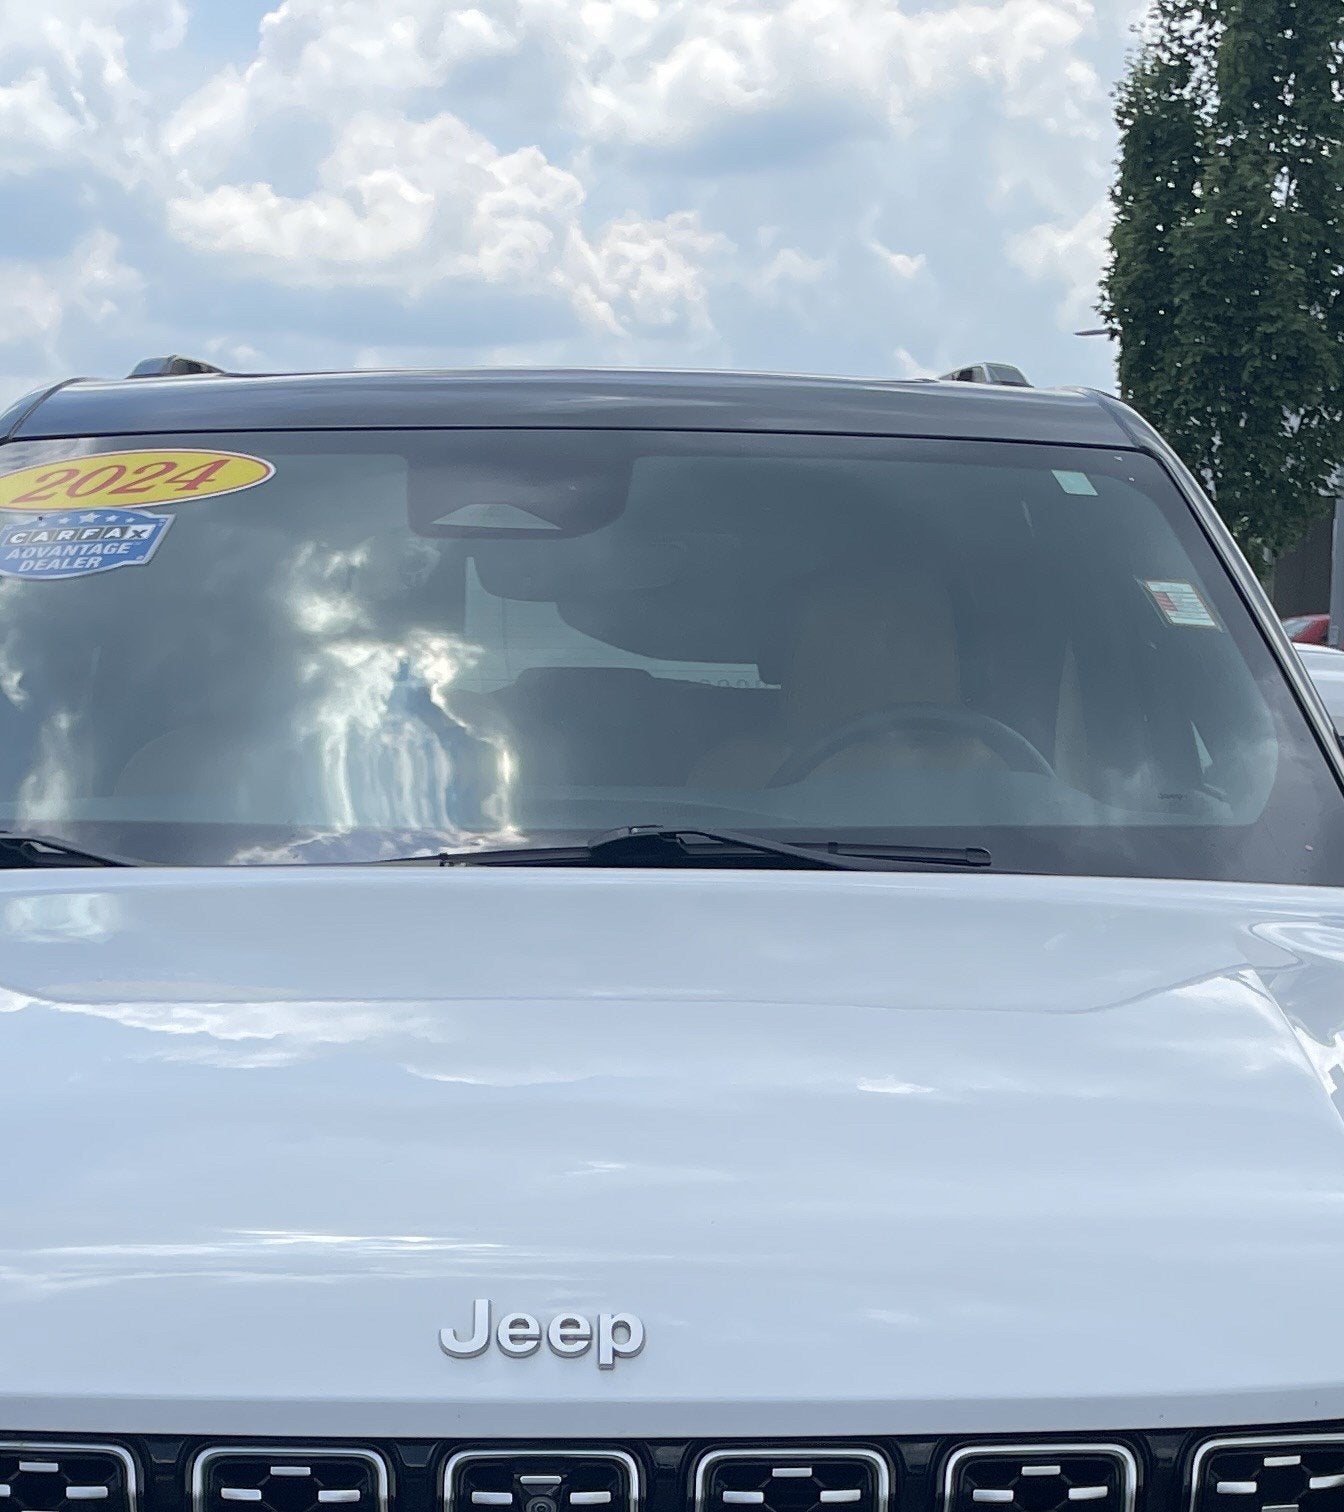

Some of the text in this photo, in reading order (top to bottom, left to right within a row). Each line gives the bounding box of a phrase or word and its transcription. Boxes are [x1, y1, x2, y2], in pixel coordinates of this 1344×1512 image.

[9, 458, 231, 504] 2024
[9, 528, 149, 544] CARFAX
[5, 542, 133, 560] ADVANTAGE
[18, 556, 102, 572] DEALER
[438, 1298, 647, 1371] Jeep
